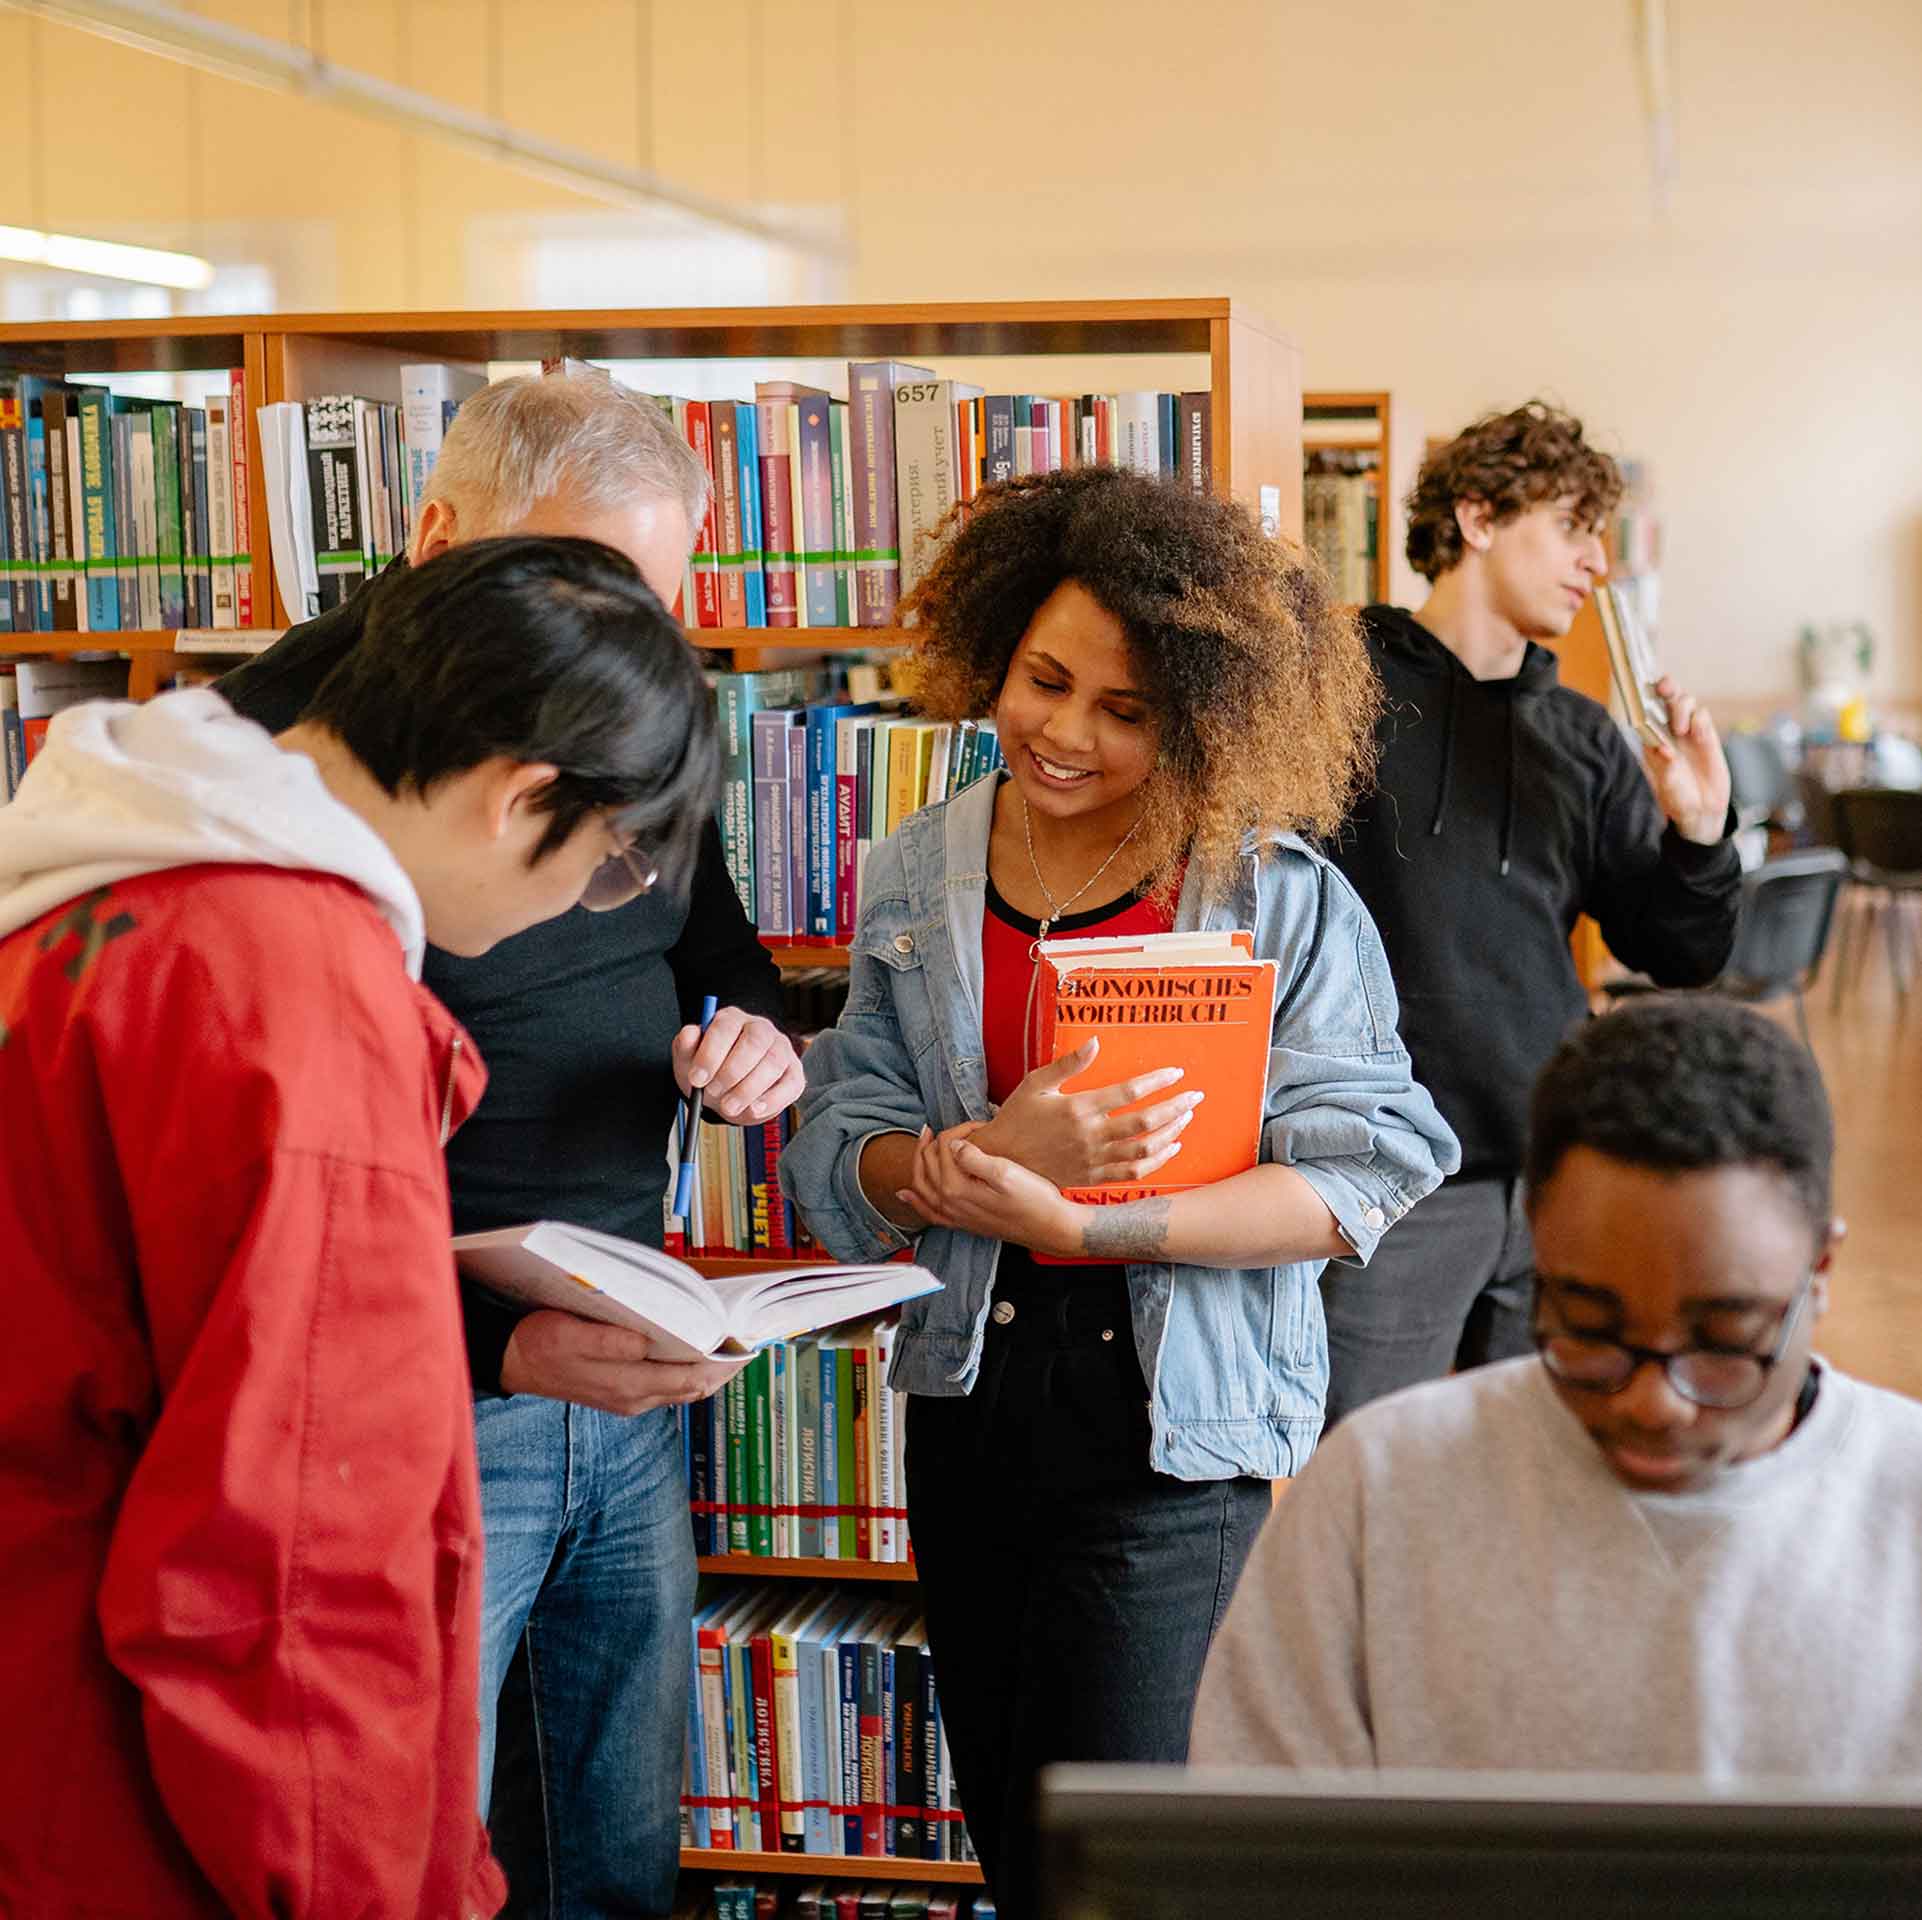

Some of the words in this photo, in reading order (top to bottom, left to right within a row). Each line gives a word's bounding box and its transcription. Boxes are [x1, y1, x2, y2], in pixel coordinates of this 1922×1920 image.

[896, 383, 941, 403] 657
[931, 426, 950, 466] учет
[335, 461, 352, 540] МАРКЕТИНГ
[736, 780, 752, 878] ФИНАНСОВЫЙ
[838, 784, 852, 837] АУДИТ
[751, 1182, 769, 1248] УЧЕТ
[801, 1427, 817, 1504] ЛОГИСТИКА
[754, 1696, 773, 1789] ЛОГИСТИКА
[883, 1691, 894, 1744] ЛОГИСТИКА
[902, 1701, 914, 1774] ЛОГИСТИКА
[860, 1735, 874, 1803] ЛОГИСТИКА
[925, 1720, 938, 1792] МЕЖДУНАРОДНАЯ
[926, 1793, 938, 1841] ЛОГТИКА
